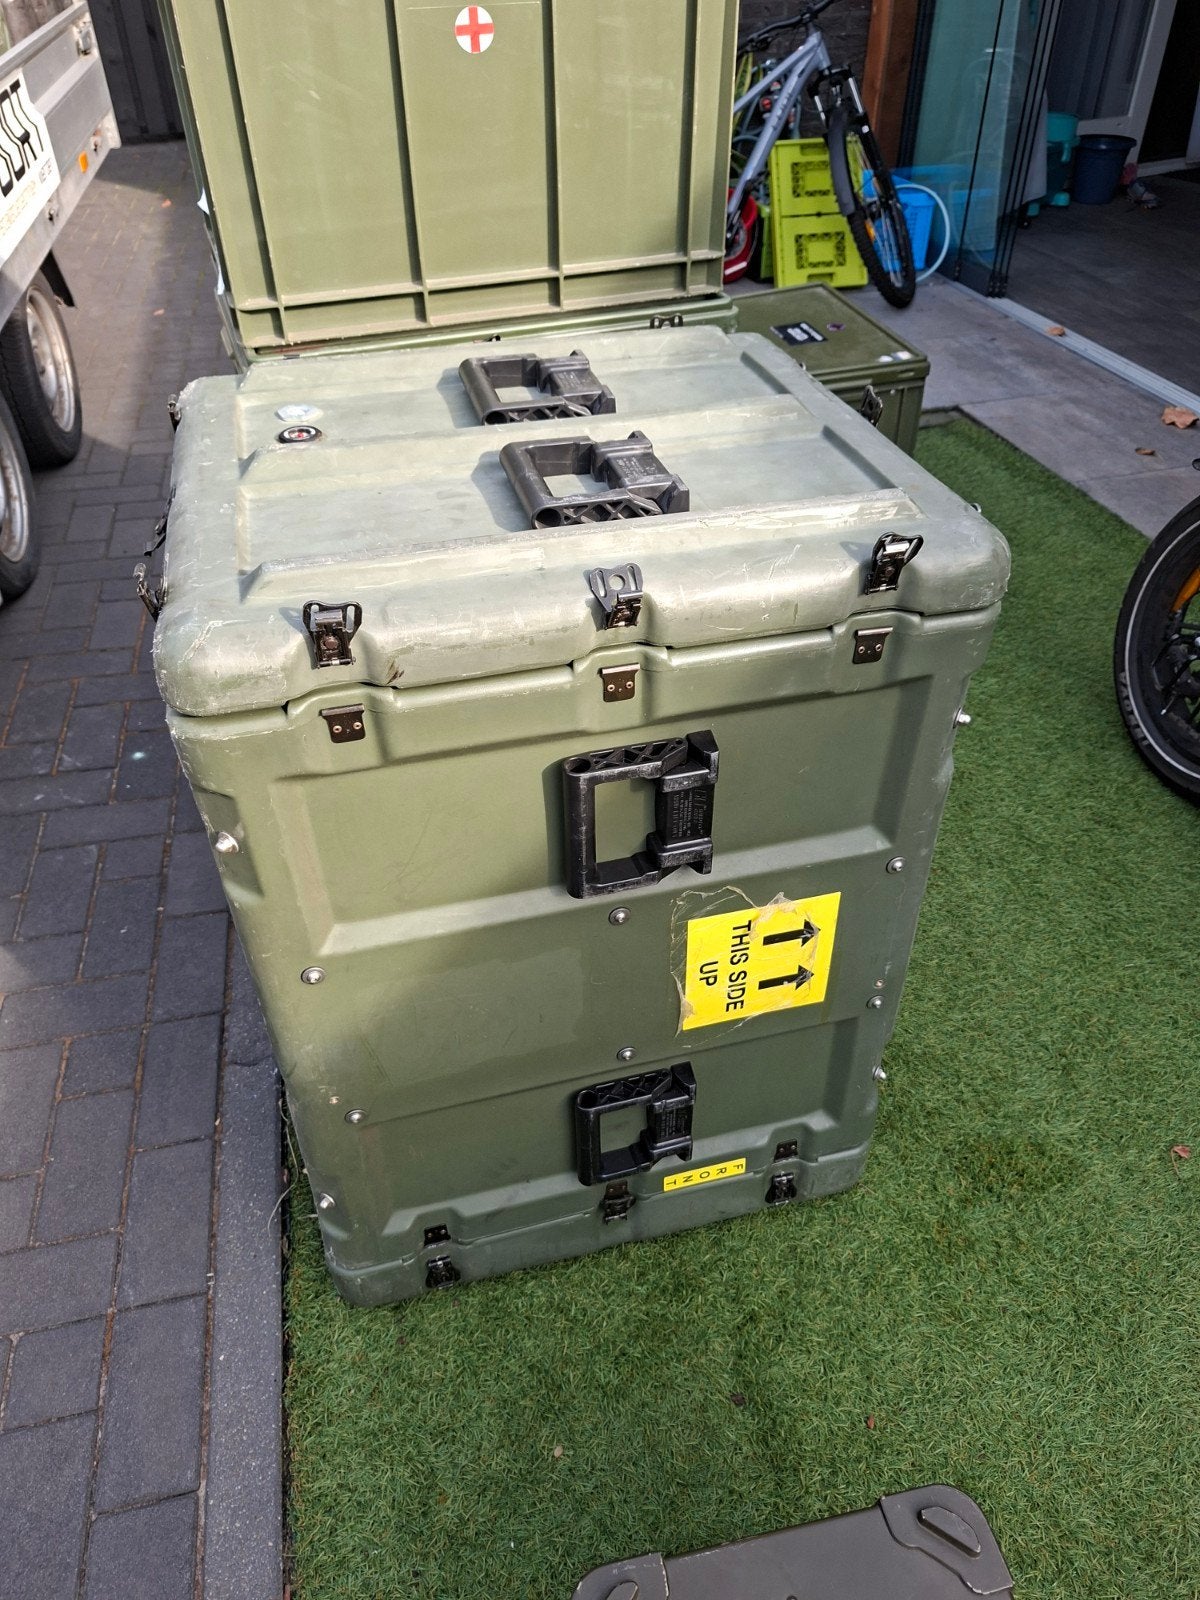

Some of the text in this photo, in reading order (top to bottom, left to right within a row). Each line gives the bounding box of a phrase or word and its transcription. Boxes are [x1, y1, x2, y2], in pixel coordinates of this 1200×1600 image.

[699, 961, 718, 987] UP
[726, 920, 751, 1012] THIS SIDE
[666, 1164, 743, 1185] FRONT
